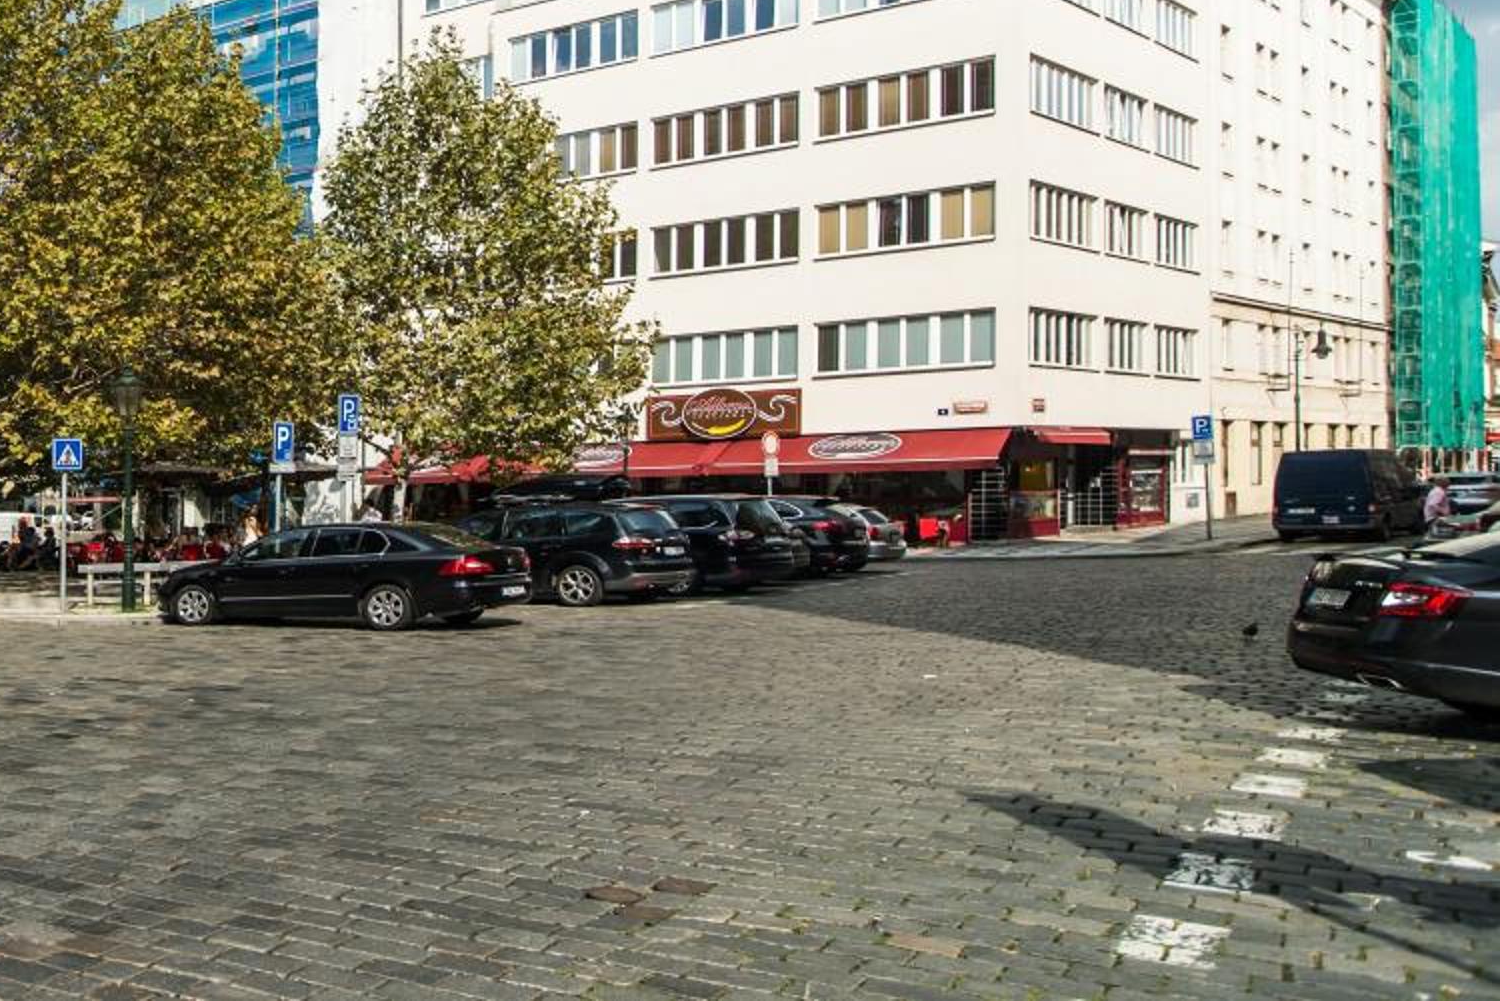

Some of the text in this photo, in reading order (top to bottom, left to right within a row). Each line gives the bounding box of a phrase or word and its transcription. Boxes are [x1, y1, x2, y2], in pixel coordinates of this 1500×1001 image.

[344, 400, 355, 422] P
[1195, 419, 1208, 434] P
[277, 426, 289, 450] P
